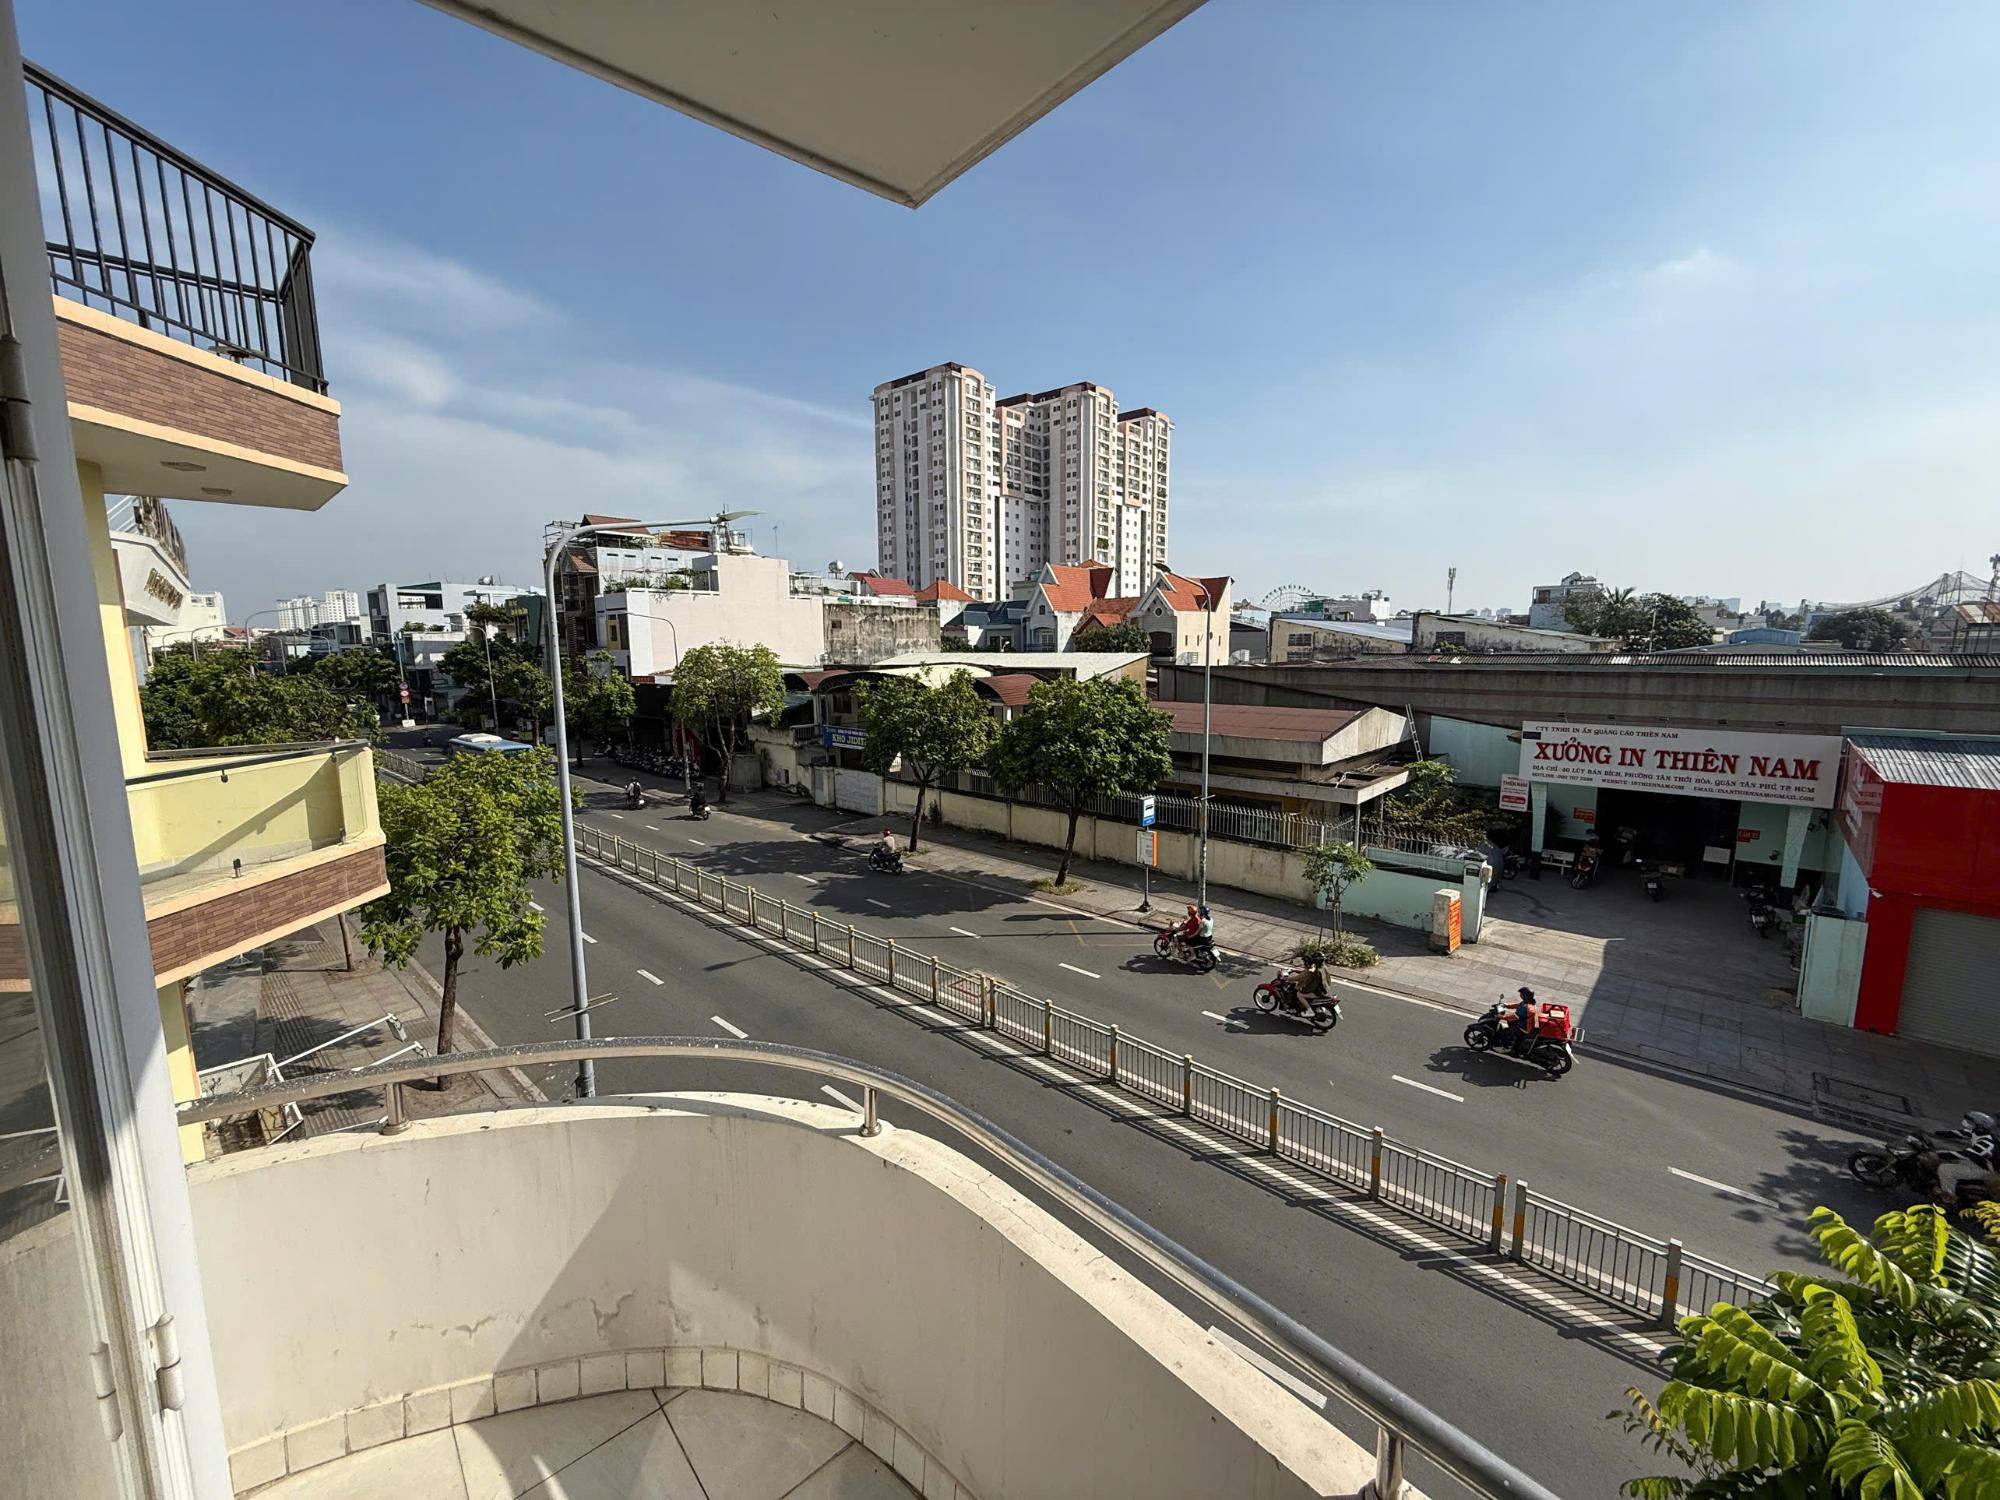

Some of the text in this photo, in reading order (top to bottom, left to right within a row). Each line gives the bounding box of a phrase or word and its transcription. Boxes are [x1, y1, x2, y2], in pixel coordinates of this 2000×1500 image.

[1534, 736, 1822, 781] XƯỞNG IN THIÊN NAM
